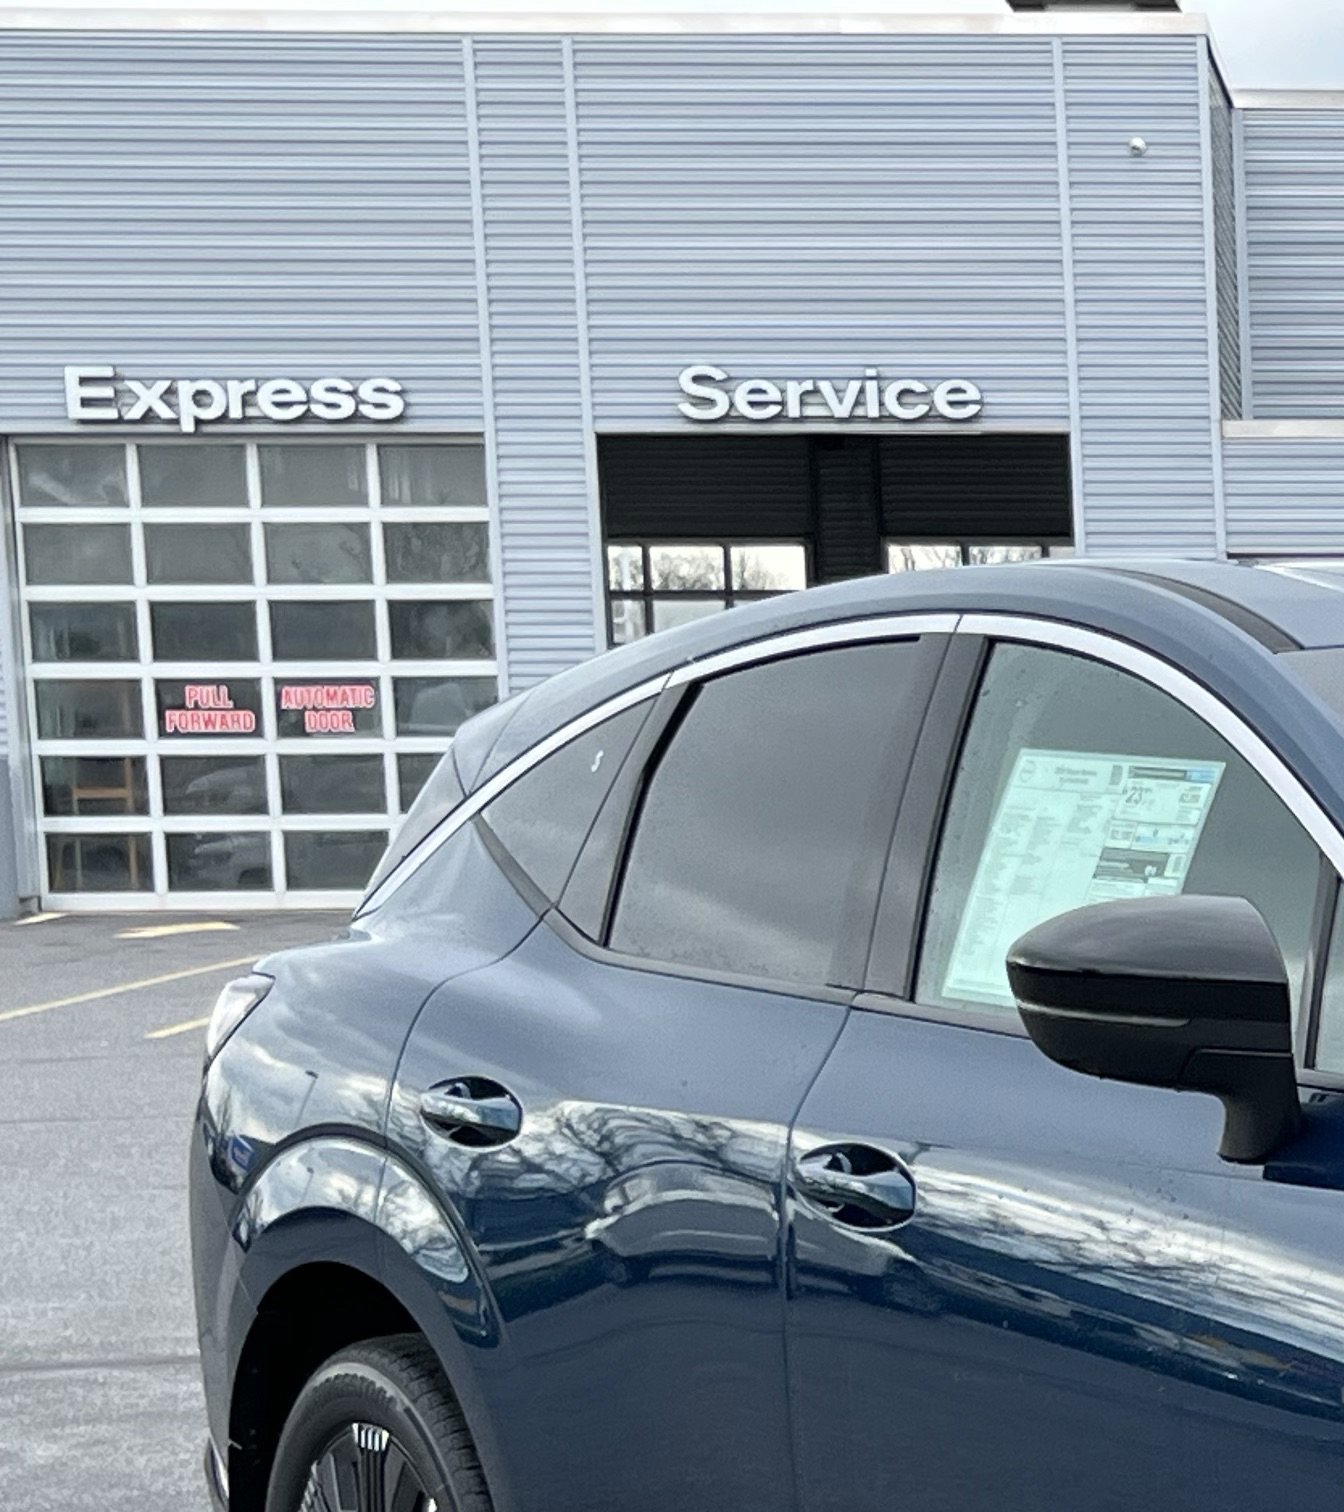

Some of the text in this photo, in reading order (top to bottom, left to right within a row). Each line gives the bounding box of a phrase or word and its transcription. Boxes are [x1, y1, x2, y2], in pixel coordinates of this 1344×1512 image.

[63, 365, 406, 434] Express
[676, 364, 983, 421] Service
[185, 685, 234, 709] PULL
[281, 685, 376, 709] AUTOMATIC
[165, 710, 256, 733] FORWARD
[304, 710, 356, 733] DOOR
